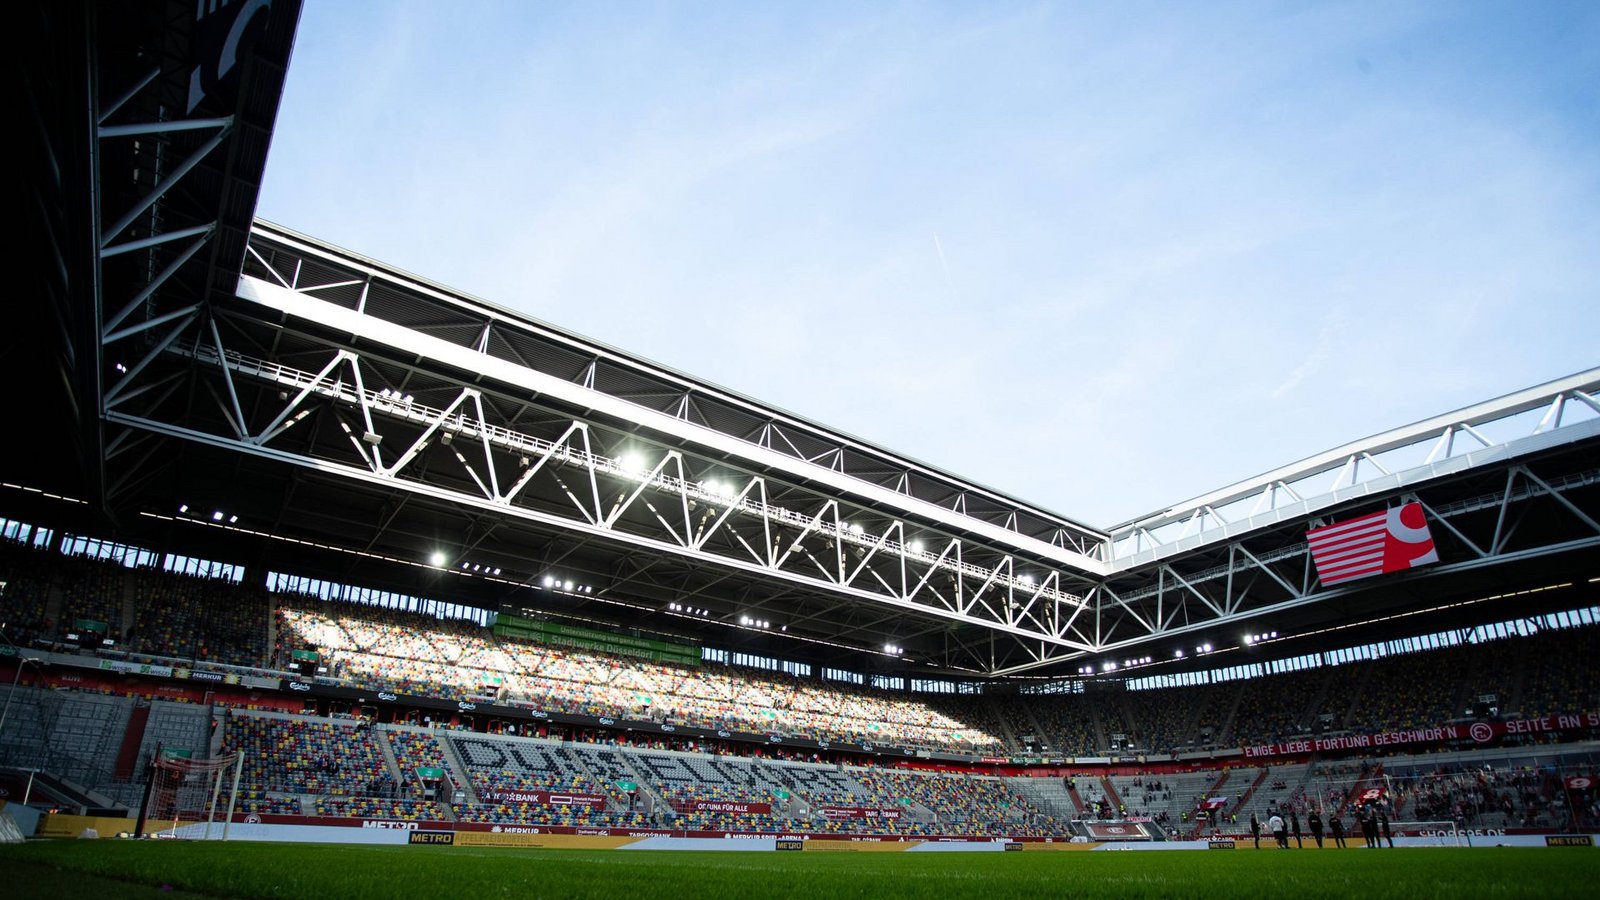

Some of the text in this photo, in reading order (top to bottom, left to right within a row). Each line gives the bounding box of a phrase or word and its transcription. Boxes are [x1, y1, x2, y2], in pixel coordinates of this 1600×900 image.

[552, 635, 605, 652] Stadtwerke
[606, 643, 653, 659] Düsseldorf
[193, 672, 222, 681] MERKUR
[1506, 713, 1600, 733] SEITE AN S
[1245, 746, 1275, 758] EWIGE
[1279, 742, 1312, 755] LIEBE
[1315, 735, 1370, 752] FORTUNA
[1569, 777, 1591, 789] 9
[1363, 788, 1380, 799] 8
[411, 832, 452, 844] METRO
[1547, 837, 1588, 846] METRO
[777, 841, 802, 849] METRO
